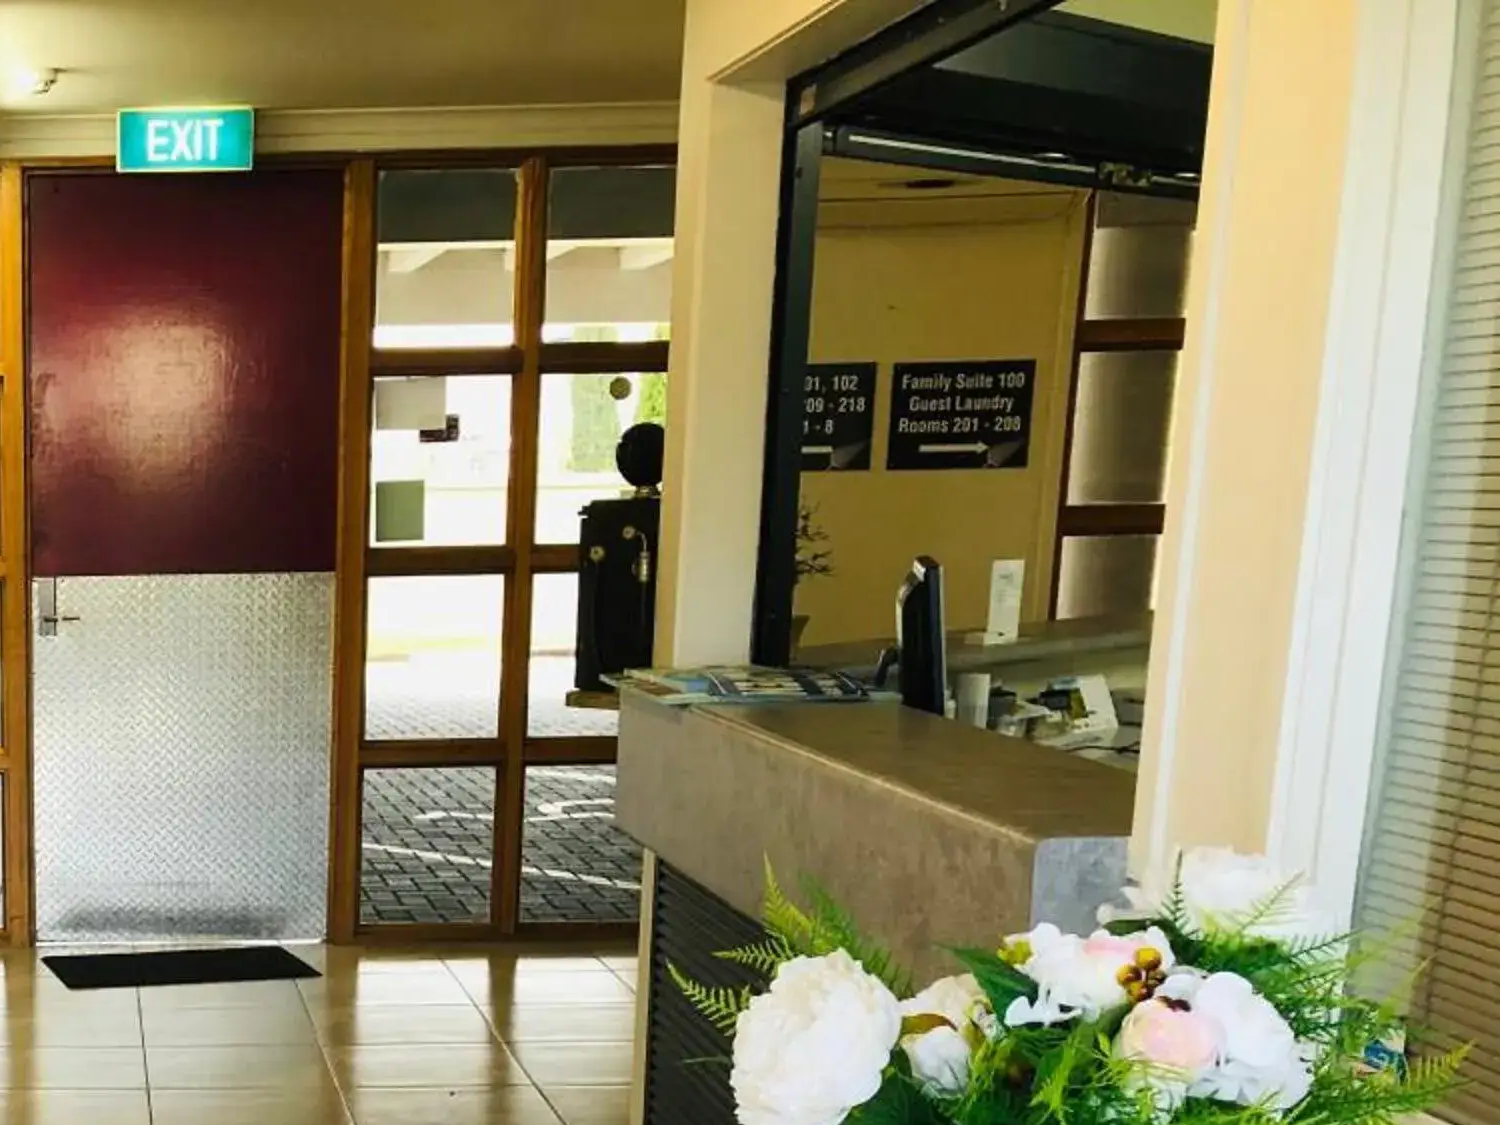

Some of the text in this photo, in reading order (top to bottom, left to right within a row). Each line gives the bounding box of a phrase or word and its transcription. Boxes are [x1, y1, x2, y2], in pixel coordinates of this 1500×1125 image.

[147, 118, 224, 161] EXIT
[831, 375, 858, 391] 102
[901, 371, 1026, 392] Family Suite 100
[838, 397, 866, 413] 218
[909, 394, 1015, 412] Guest Laundry
[824, 419, 834, 434] 8
[898, 417, 949, 433] Rooms
[952, 416, 979, 433] 201
